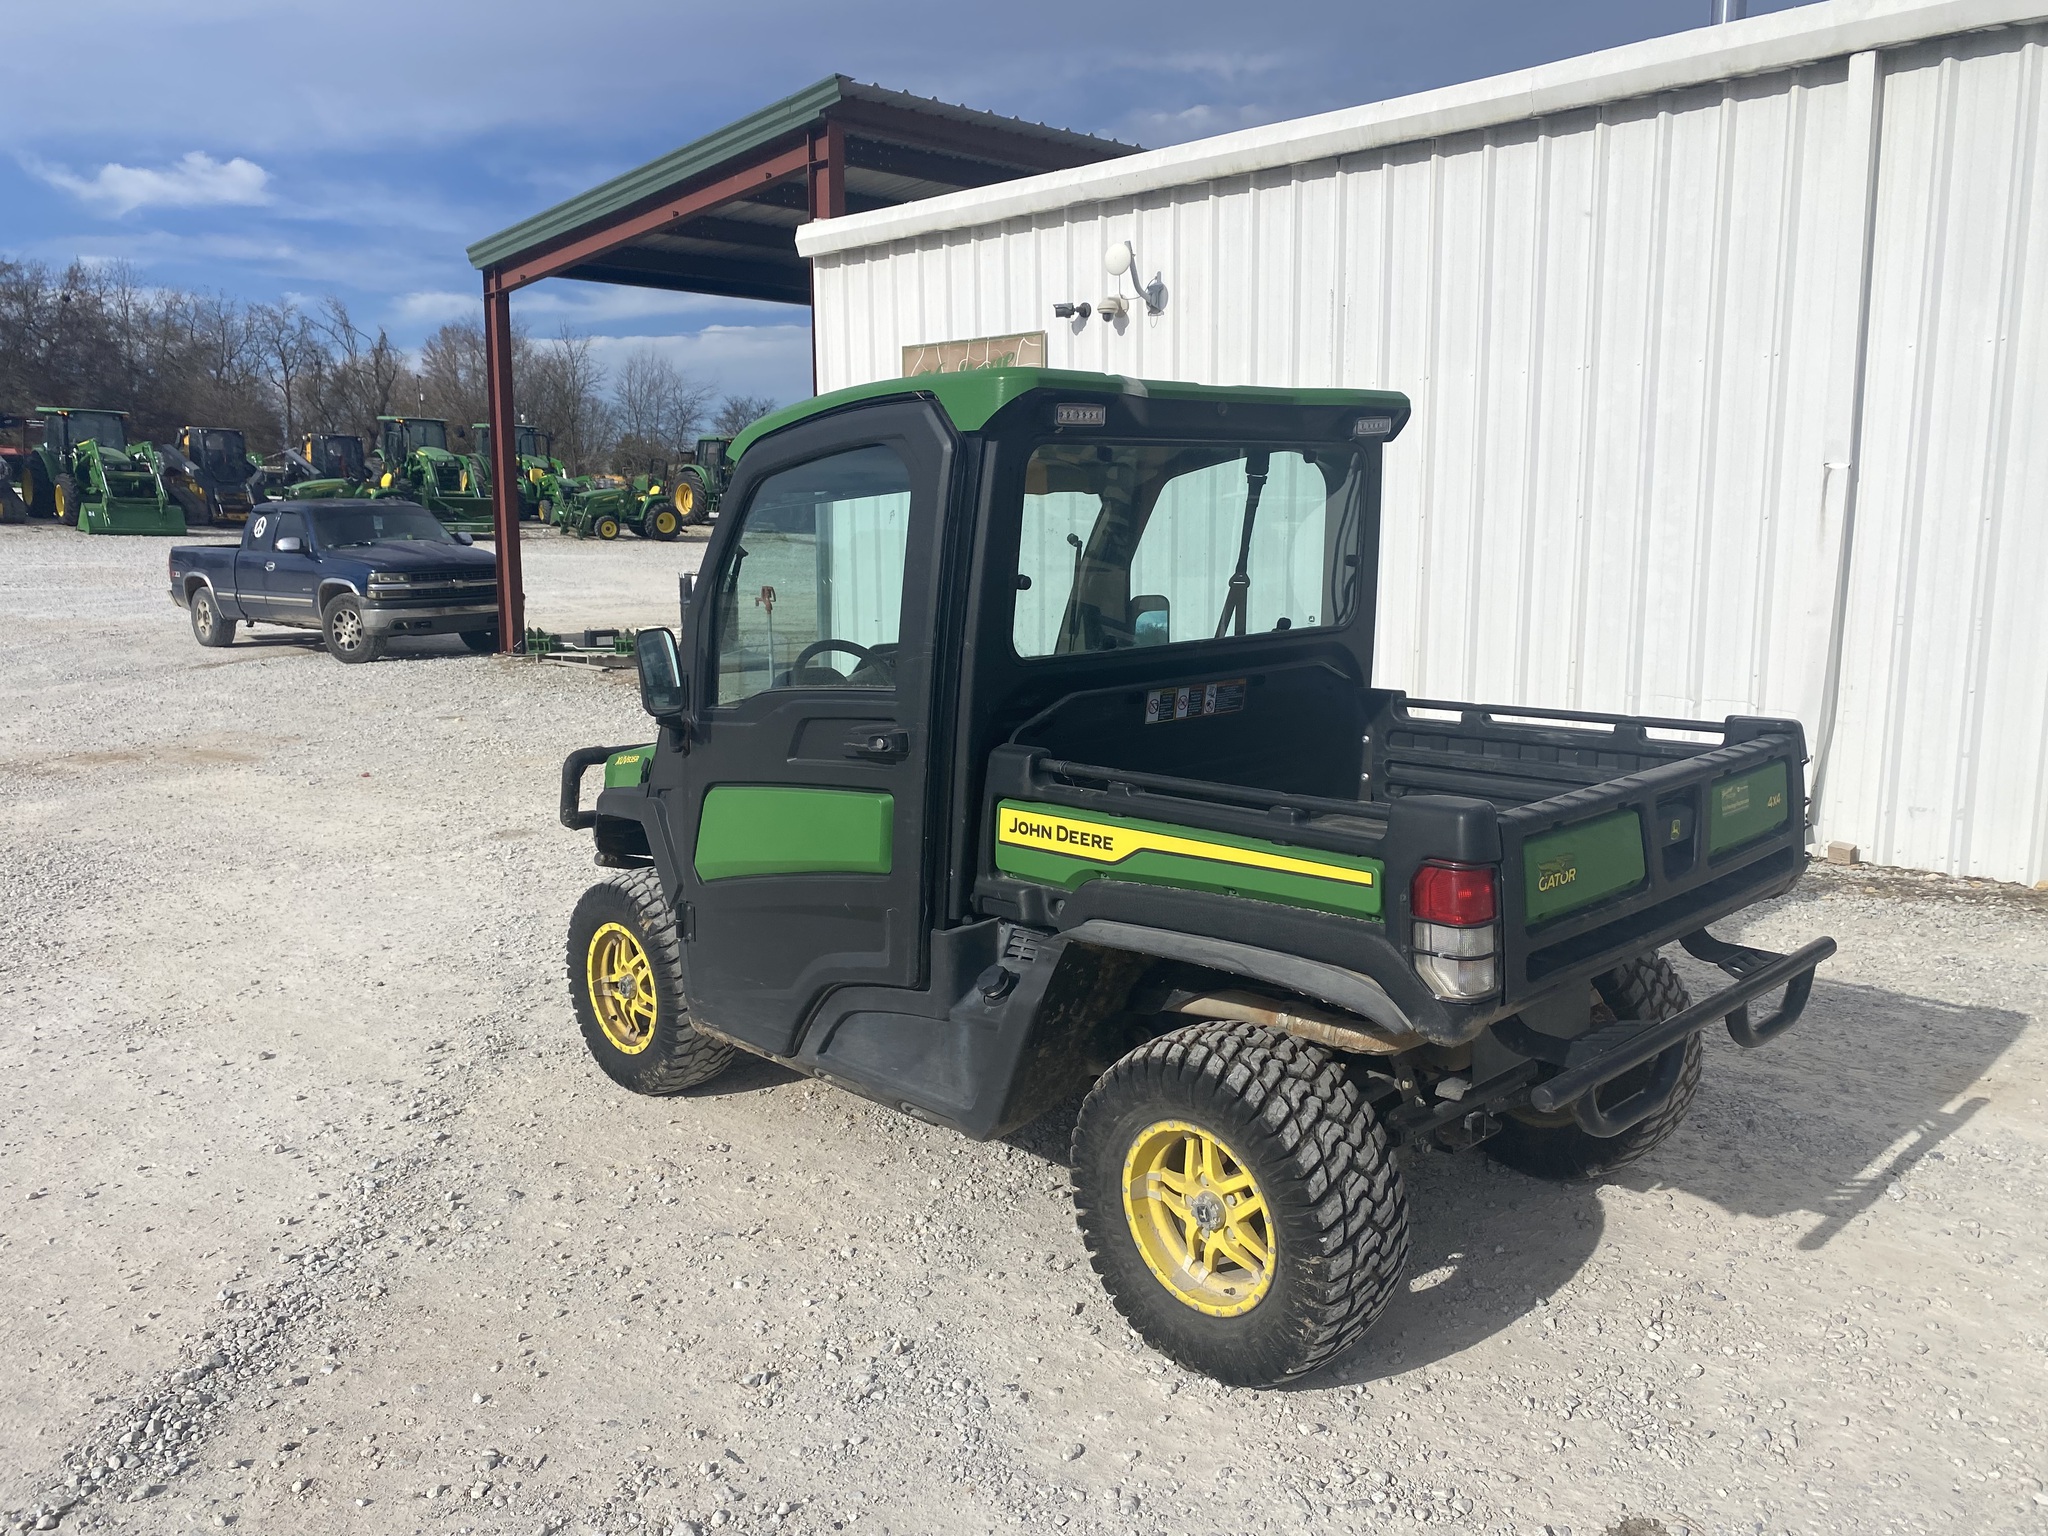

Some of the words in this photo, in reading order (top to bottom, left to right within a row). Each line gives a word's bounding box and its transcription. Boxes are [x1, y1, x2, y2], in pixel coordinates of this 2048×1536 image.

[1009, 817, 1052, 840] JOHN
[1056, 824, 1114, 851] DEERE
[1538, 867, 1577, 892] GATOR
